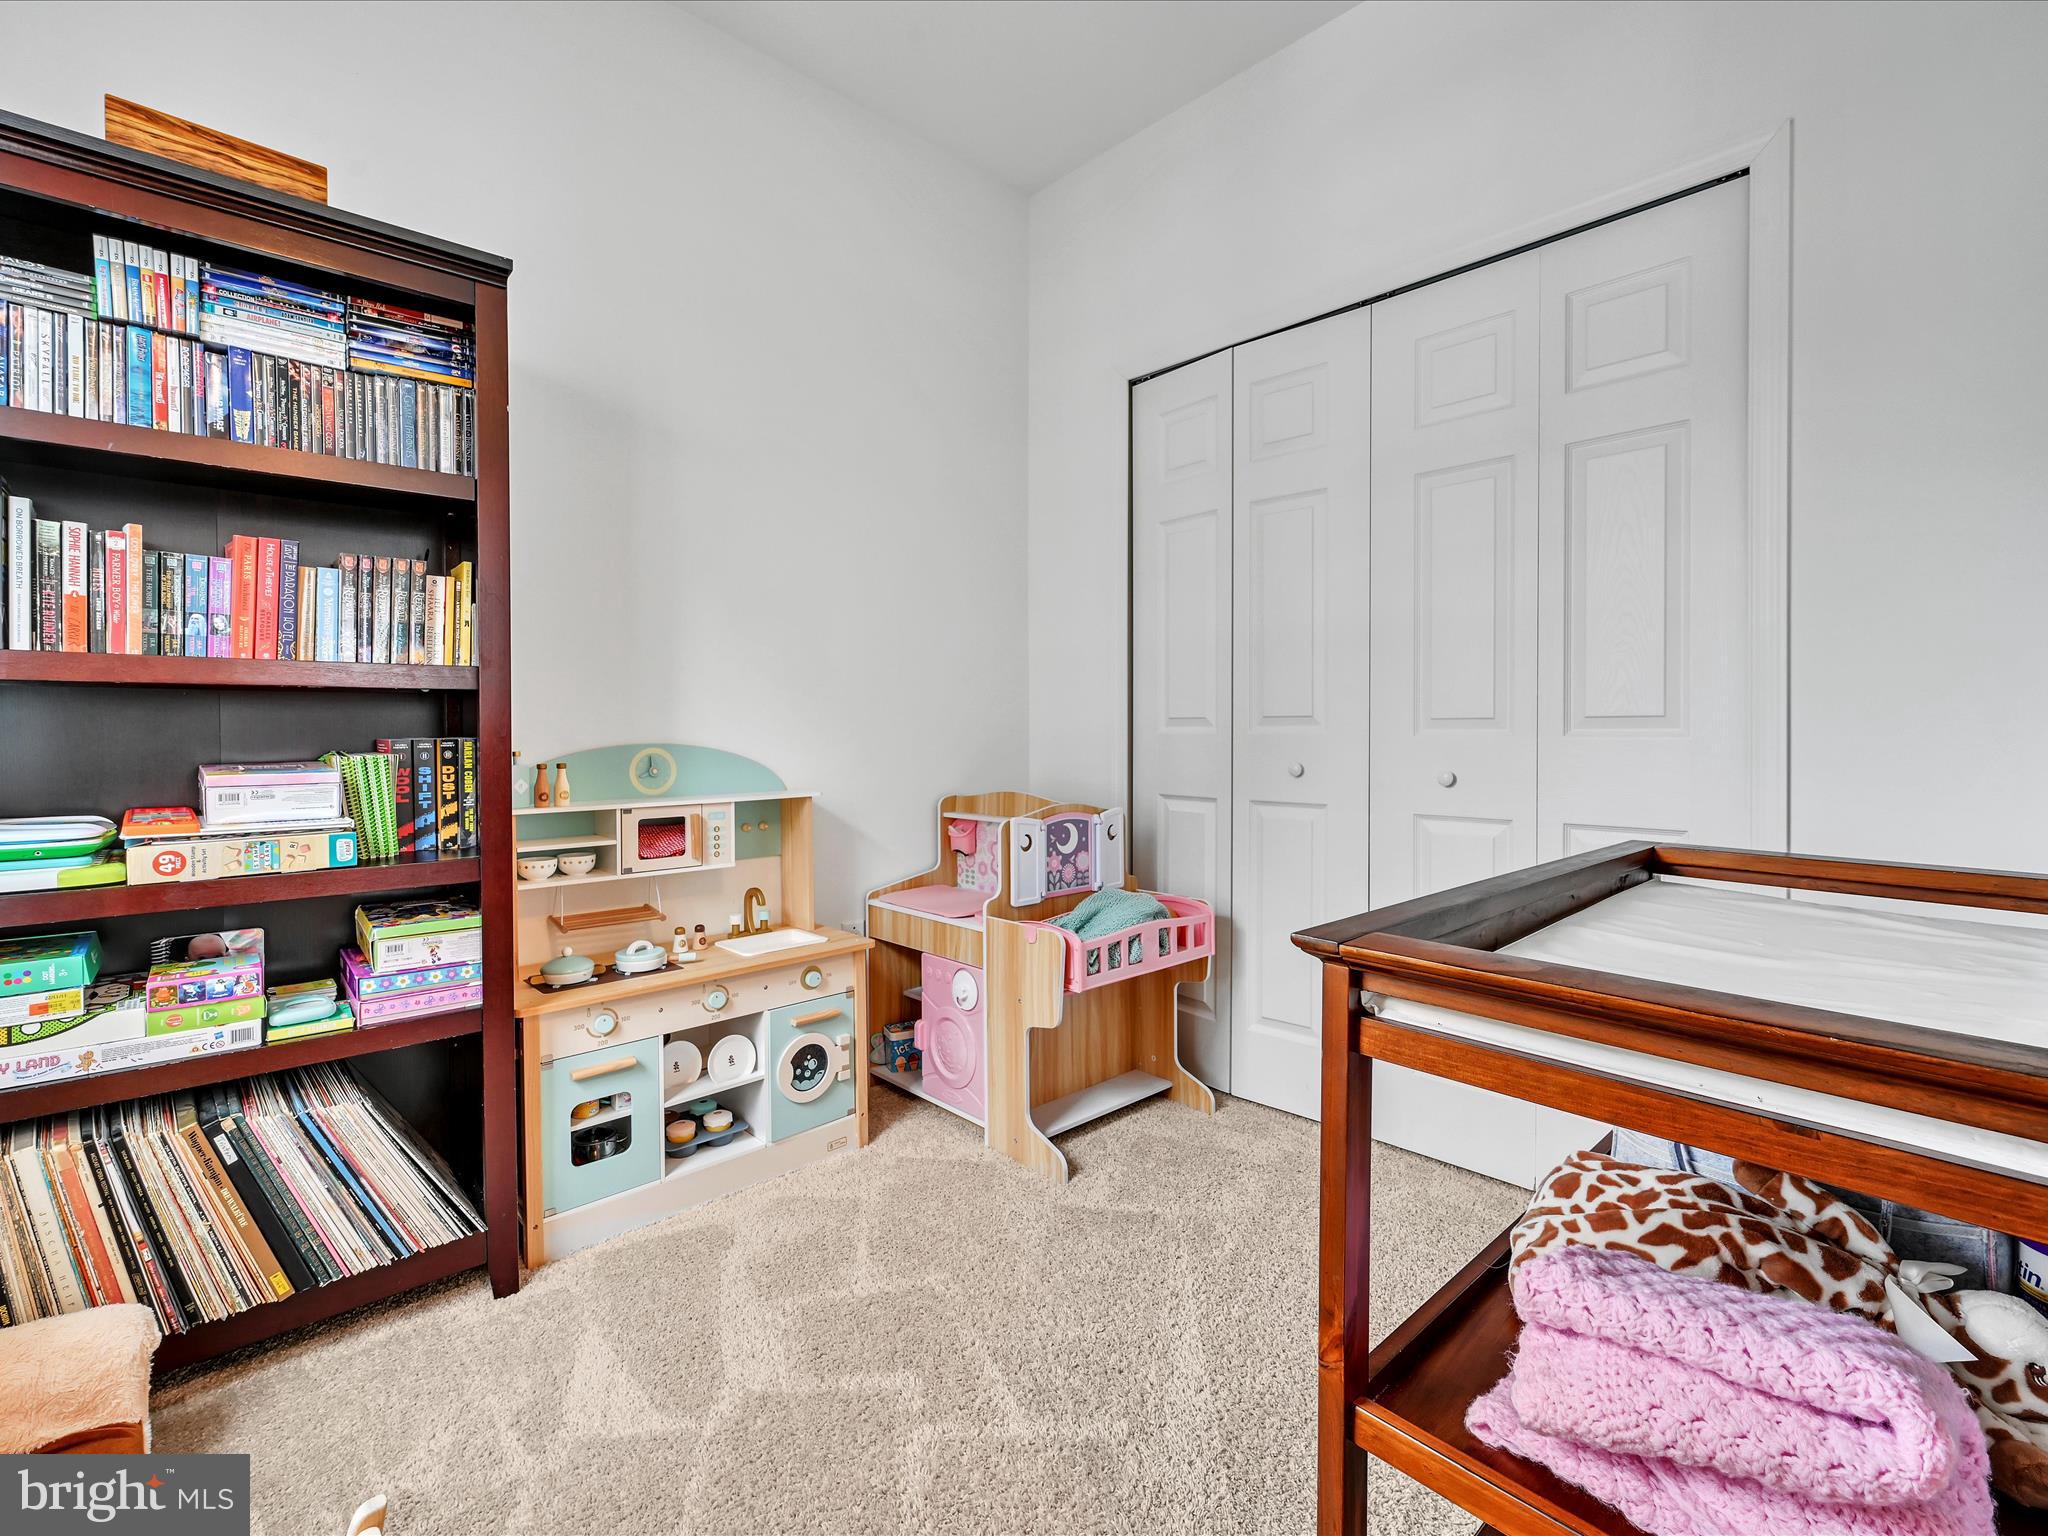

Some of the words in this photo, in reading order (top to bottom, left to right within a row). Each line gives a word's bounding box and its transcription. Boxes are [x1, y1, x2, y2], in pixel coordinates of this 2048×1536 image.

[219, 289, 255, 302] COLLECTION
[246, 313, 281, 327] AIRPLANE!
[41, 333, 50, 384] SKYFALL
[12, 351, 20, 392] PATRIOT
[403, 395, 413, 419] GAME
[405, 425, 415, 458] THRONES
[16, 508, 23, 518] ON
[68, 527, 80, 552] SOPHIE
[243, 554, 252, 579] PARIS
[265, 543, 275, 567] HOUSE
[68, 555, 81, 586] HANNAH
[93, 568, 103, 591] HOLES
[112, 552, 121, 585] FARMER
[112, 587, 121, 605] BOY
[242, 581, 250, 611] Architect
[265, 570, 274, 597] THIEVES
[281, 571, 296, 613] PARAGON
[42, 591, 56, 608] KITE
[342, 587, 356, 618] REDWALL
[396, 591, 408, 622] REDWALL
[412, 592, 425, 622] REDWALL
[42, 610, 56, 644] RUNNER
[283, 617, 294, 642] HOTEL
[463, 741, 473, 769] HARLAN
[418, 766, 432, 809] SHIFT
[442, 765, 455, 800] DUST
[464, 771, 473, 793] COBEN
[159, 855, 175, 872] 49
[15, 1055, 61, 1072] LAND
[89, 1151, 100, 1168] MOZART
[94, 1167, 105, 1181] OPERA
[99, 1179, 110, 1196] FESTIVAL
[38, 1210, 62, 1267] JASCHA
